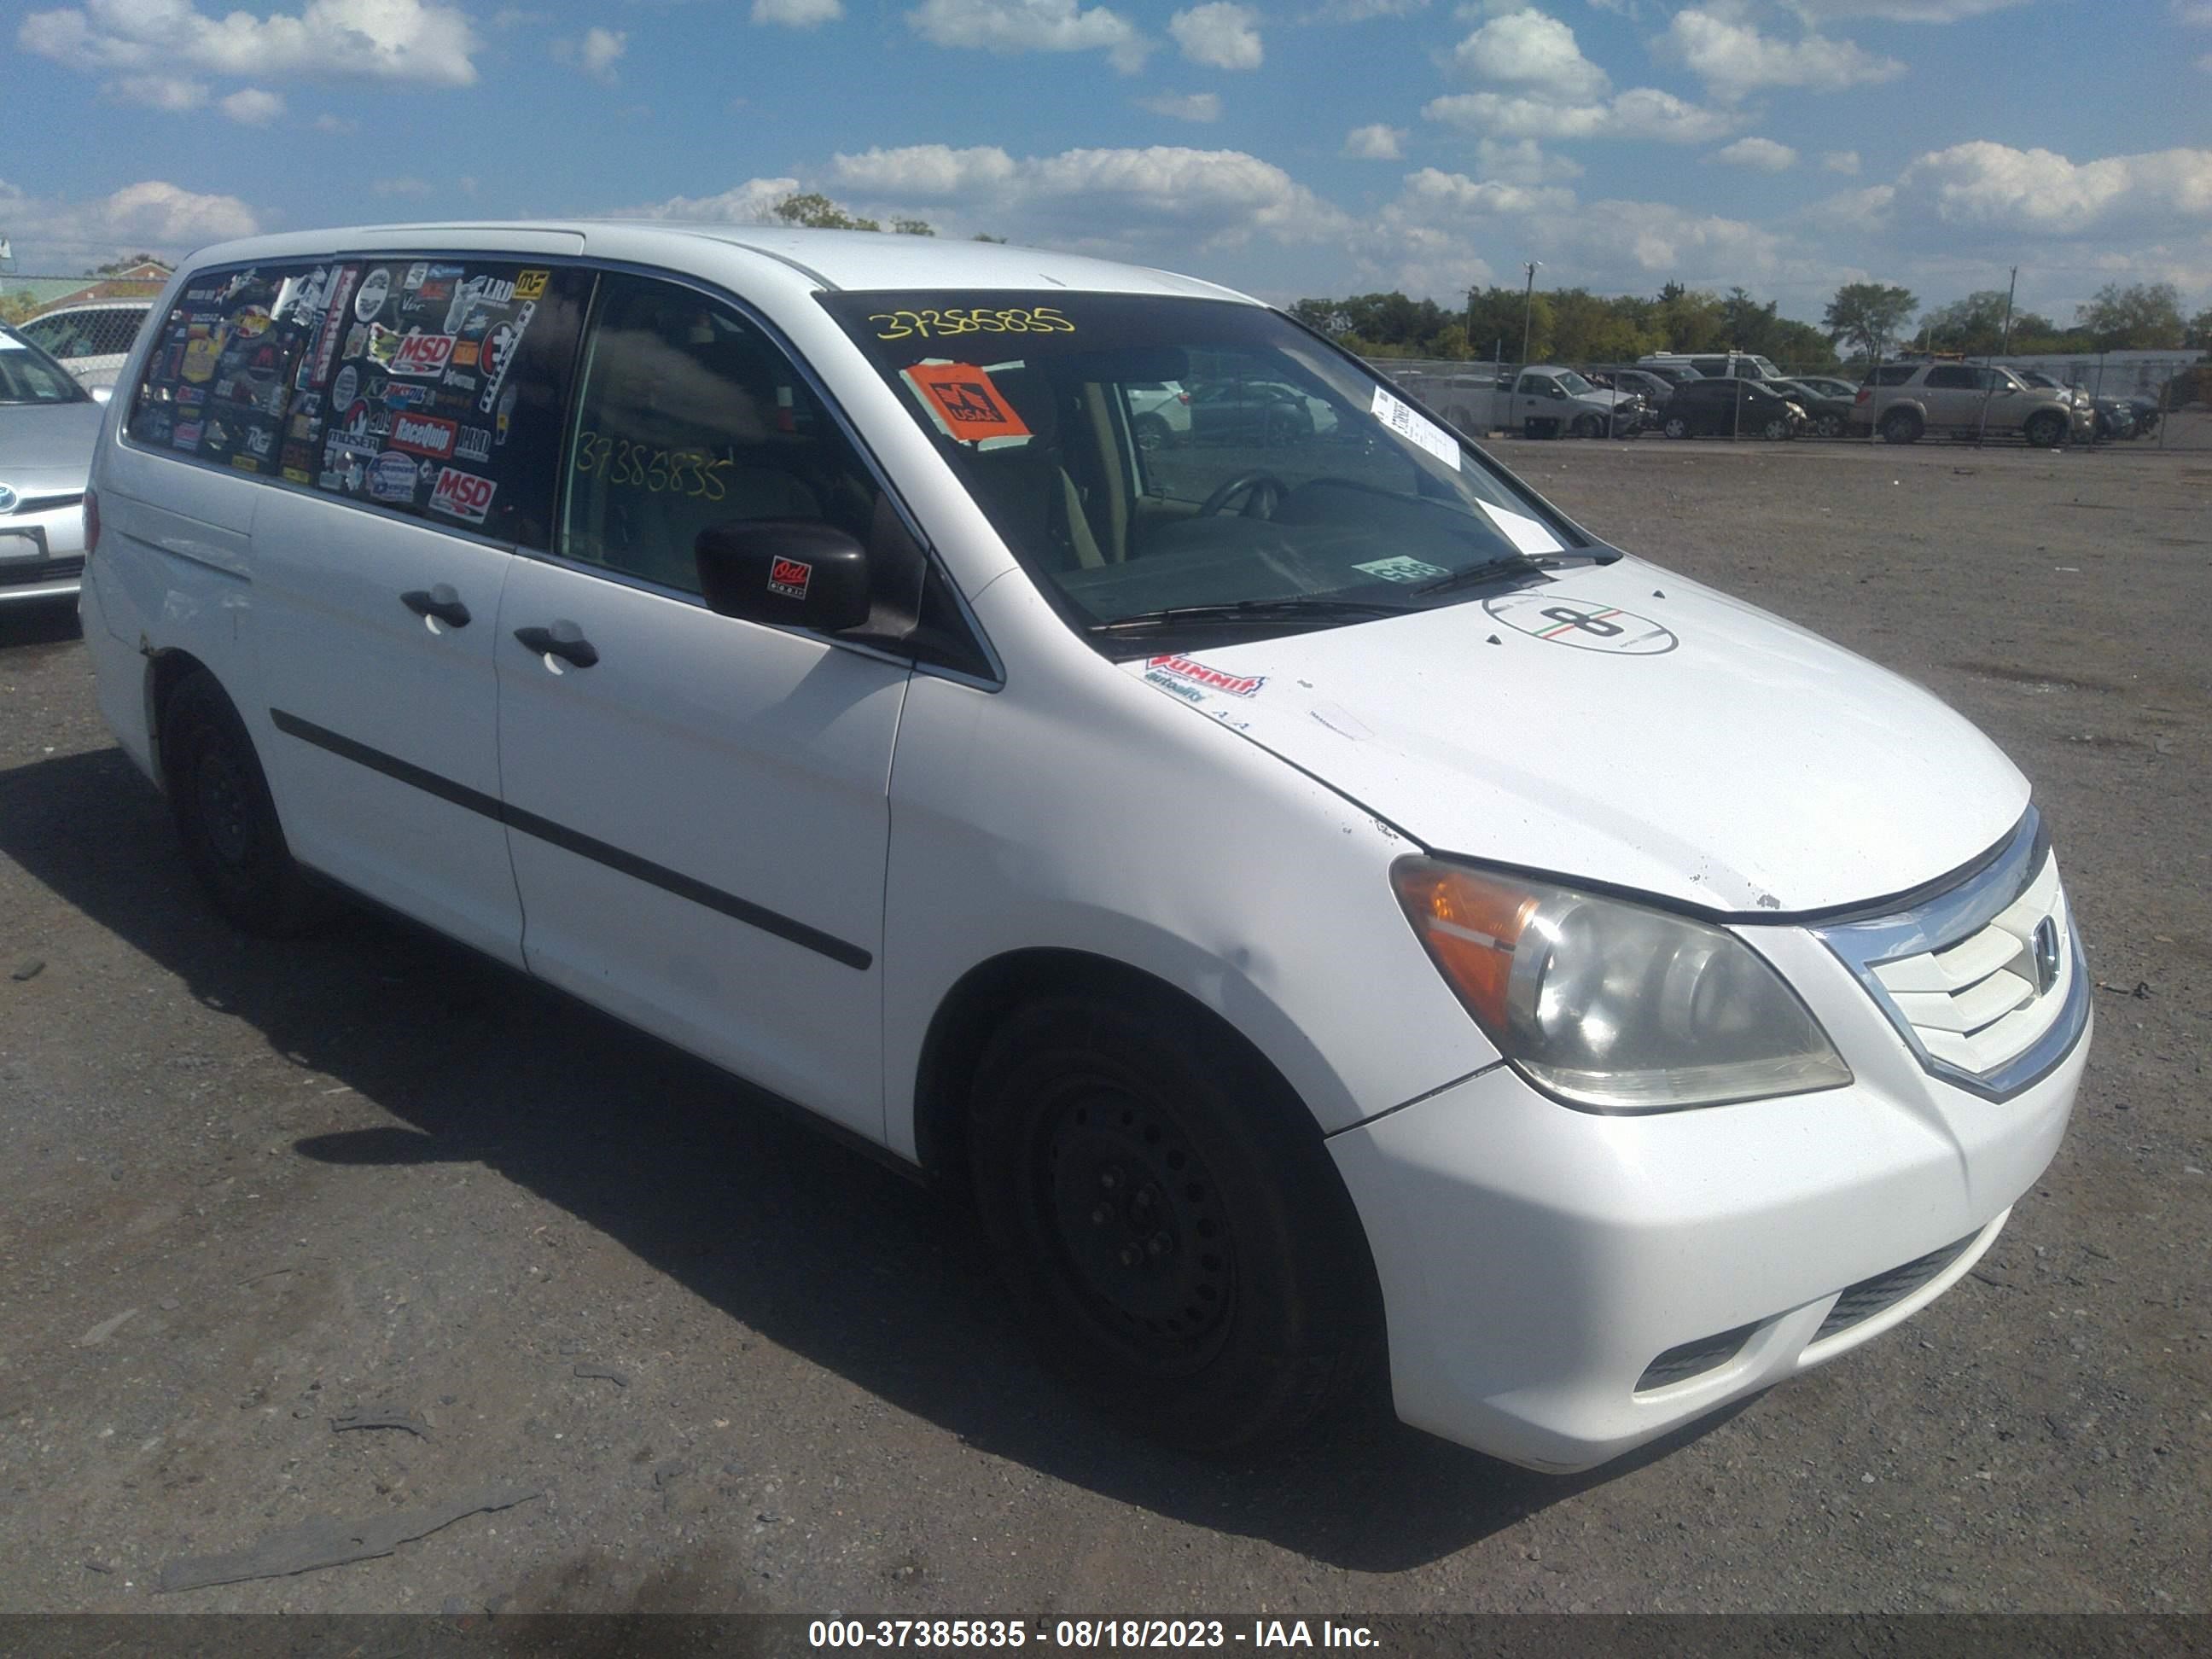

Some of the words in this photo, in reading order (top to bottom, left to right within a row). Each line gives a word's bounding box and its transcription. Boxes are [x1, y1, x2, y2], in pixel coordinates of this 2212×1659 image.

[868, 307, 1076, 339] 37385835
[397, 336, 451, 362] MSD
[952, 409, 999, 422] USAA
[395, 416, 451, 451] RaceQuip
[577, 431, 734, 501] 37385835
[436, 471, 492, 507] MSD
